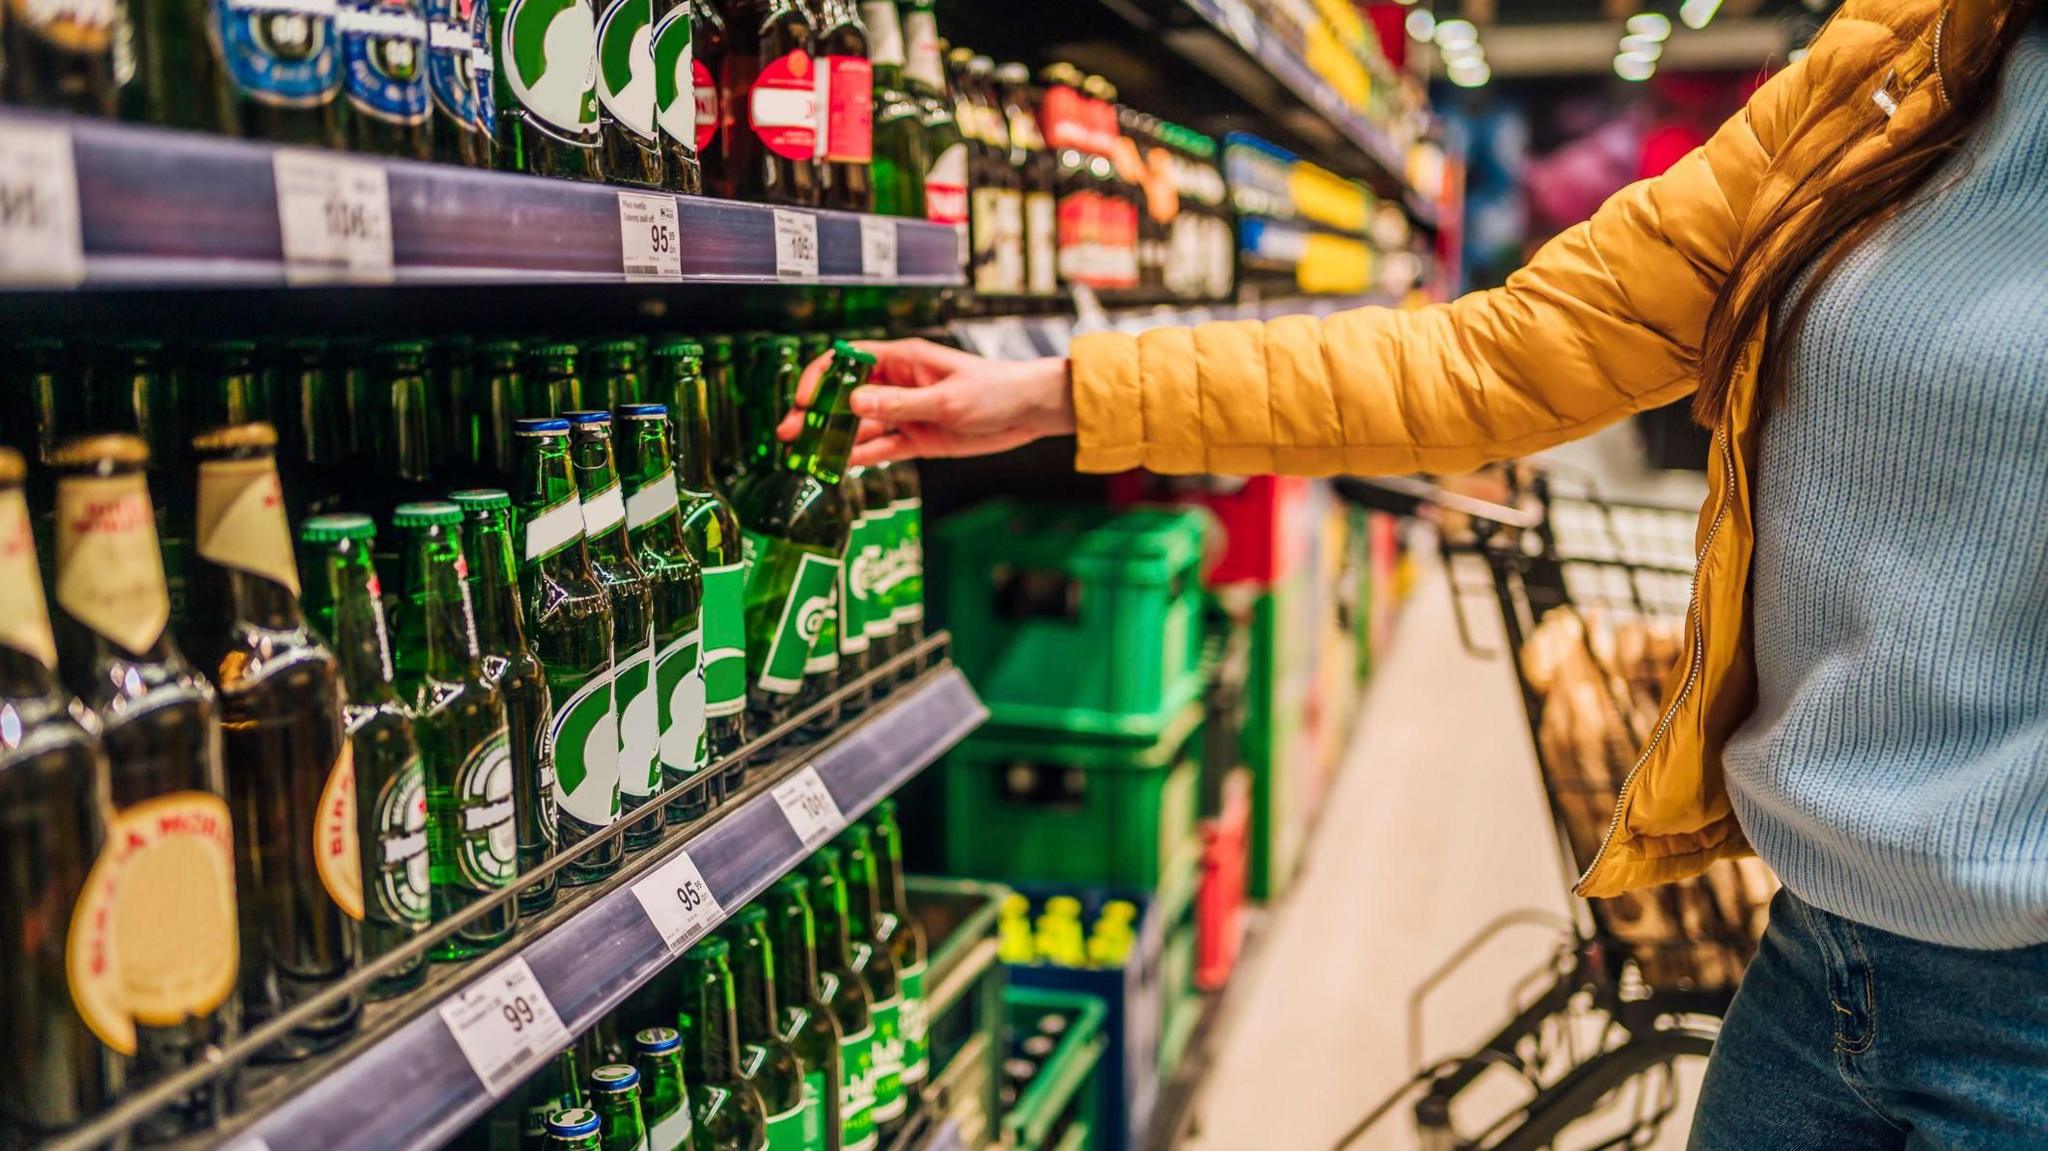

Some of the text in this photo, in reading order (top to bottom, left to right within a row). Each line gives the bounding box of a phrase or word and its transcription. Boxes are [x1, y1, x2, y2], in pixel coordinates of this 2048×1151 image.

[651, 224, 669, 253] 95
[676, 881, 701, 912] 95
[502, 996, 535, 1033] 99
